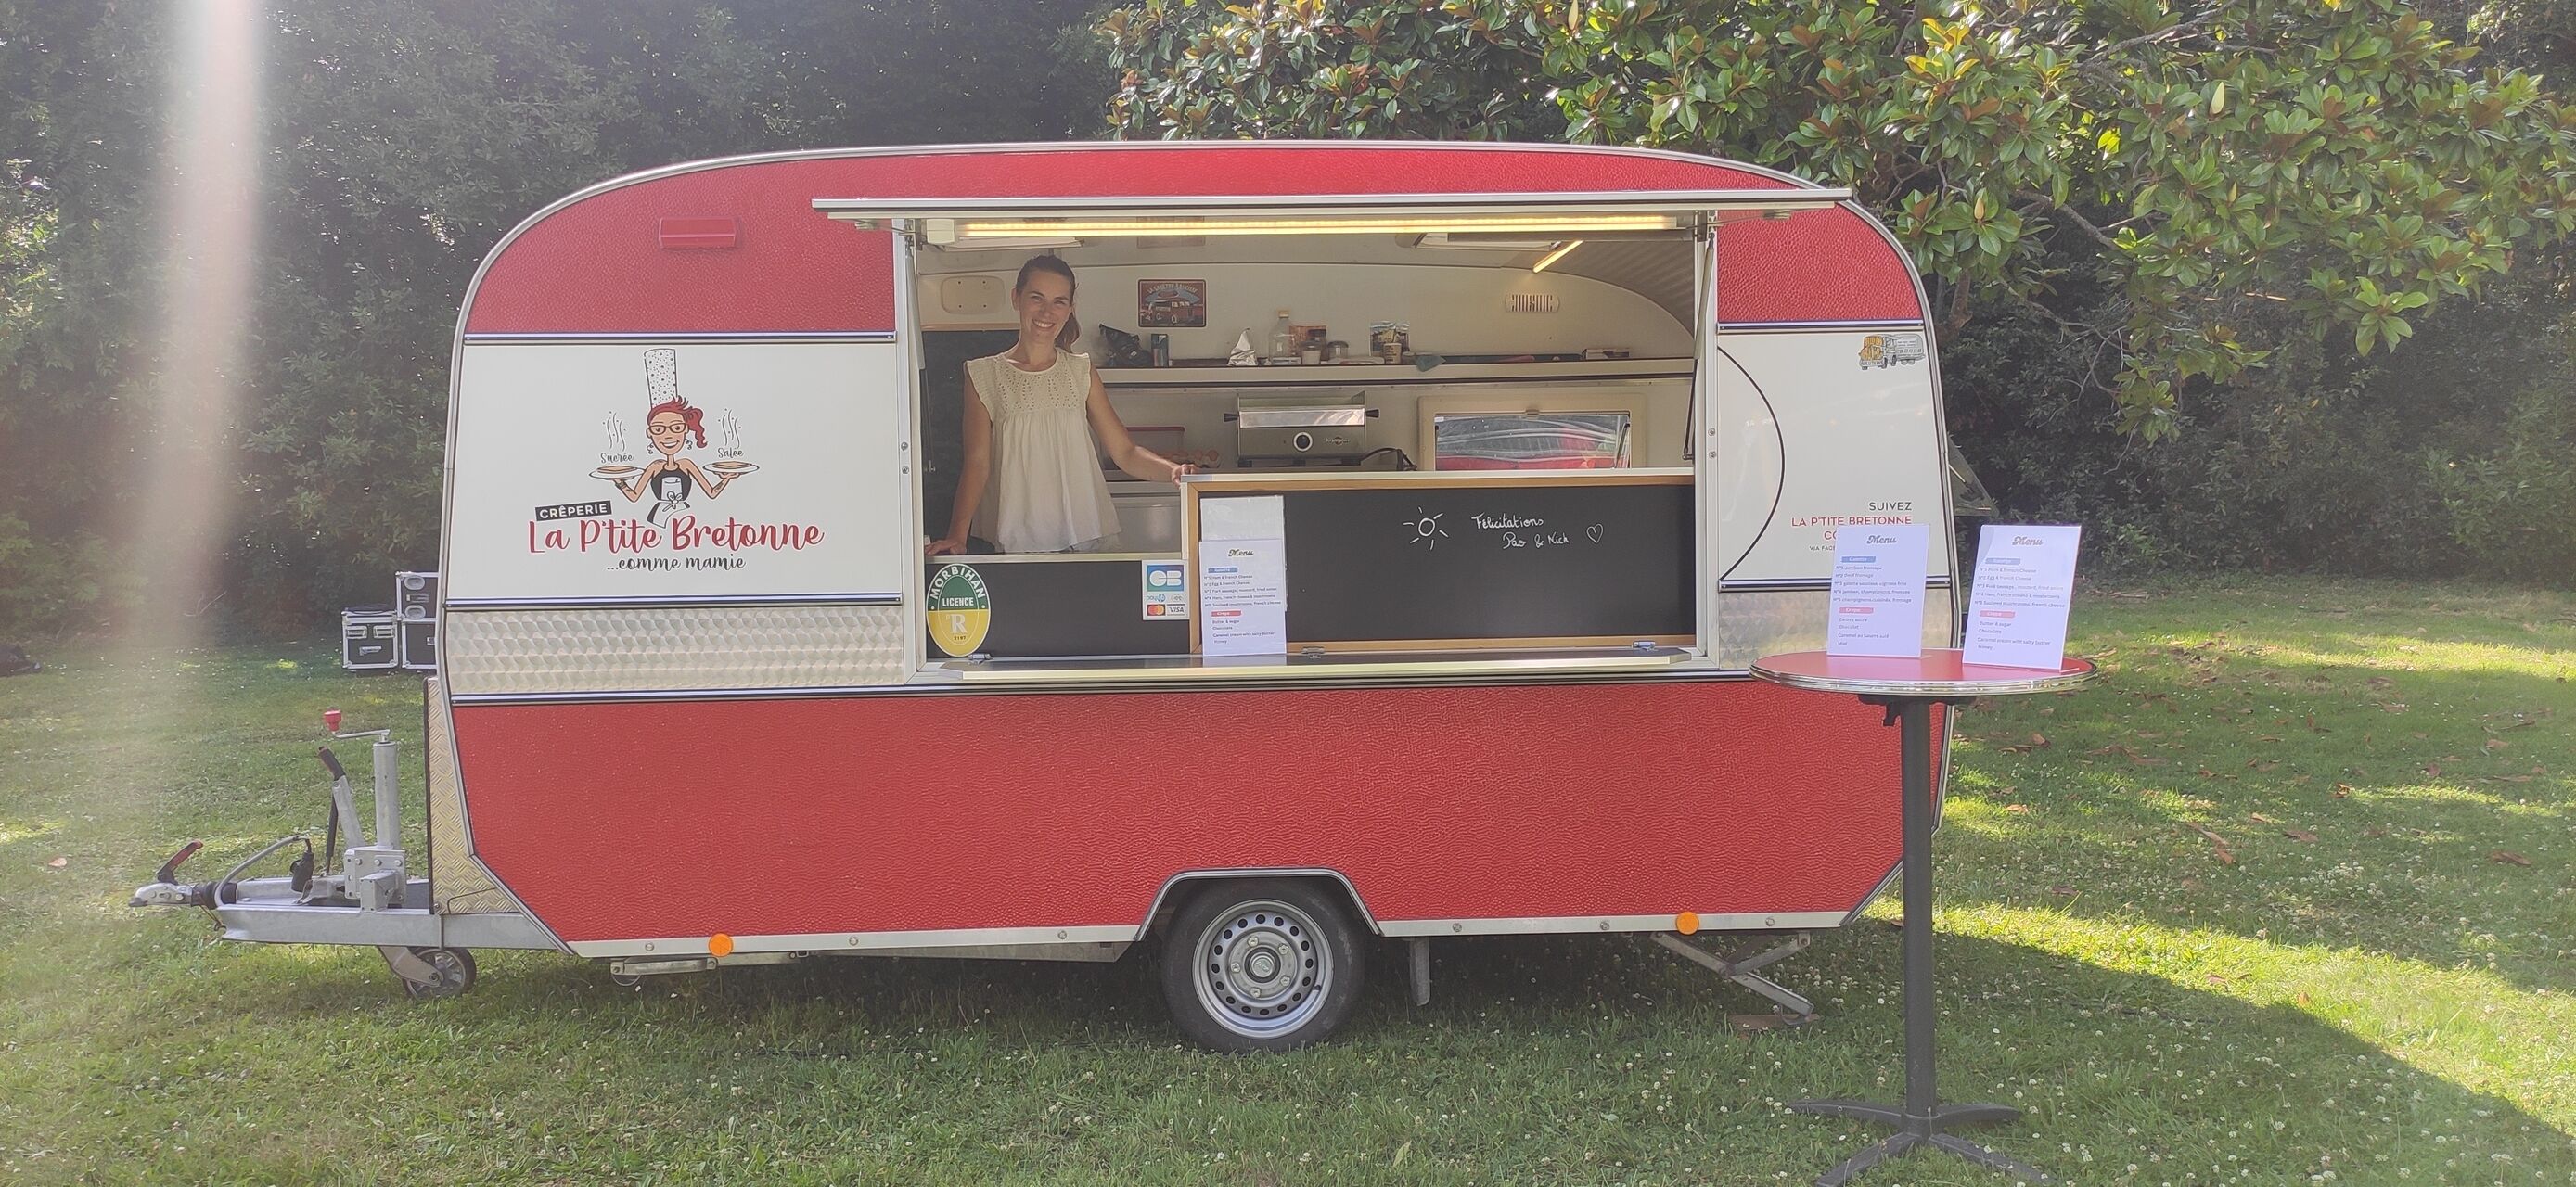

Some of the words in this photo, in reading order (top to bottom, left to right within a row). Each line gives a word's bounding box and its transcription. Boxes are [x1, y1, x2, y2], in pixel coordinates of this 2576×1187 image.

[600, 453, 634, 464] Sucrée
[717, 447, 744, 459] Salée
[539, 503, 608, 519] CRÊPERIE
[1869, 502, 1912, 511] SUIVEZ
[1791, 517, 1807, 527] LA
[1849, 516, 1912, 526] BRETONNE
[529, 520, 570, 554] La
[580, 518, 662, 554] P'tite
[672, 515, 825, 552] Bretonne
[1534, 534, 1544, 548] &
[1547, 531, 1570, 545] Nick
[1866, 535, 1897, 544] Menu
[2012, 536, 2043, 545] Menu
[686, 554, 746, 571] mamie
[930, 566, 986, 600] MORBIHAN
[1150, 570, 1182, 586] CB
[942, 597, 974, 606] LICENCE
